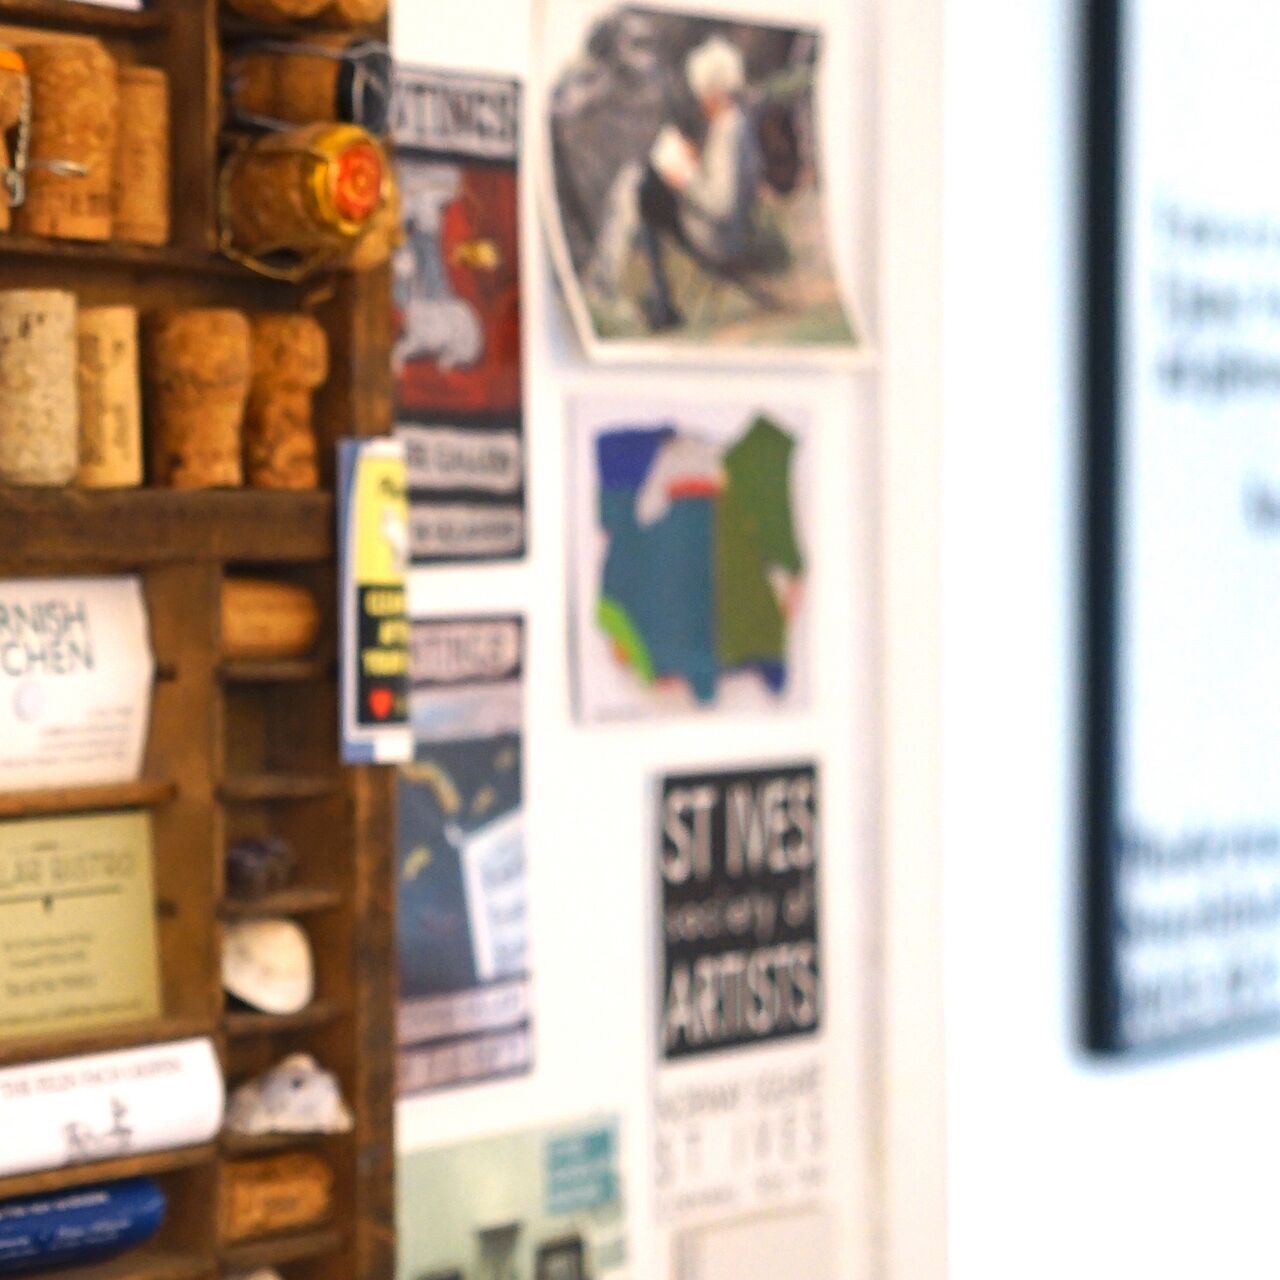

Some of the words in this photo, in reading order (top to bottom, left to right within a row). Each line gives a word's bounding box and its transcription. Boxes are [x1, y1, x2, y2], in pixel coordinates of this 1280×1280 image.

[661, 783, 719, 886] ST
[724, 774, 815, 879] IVES
[663, 939, 818, 1056] ARTISTS
